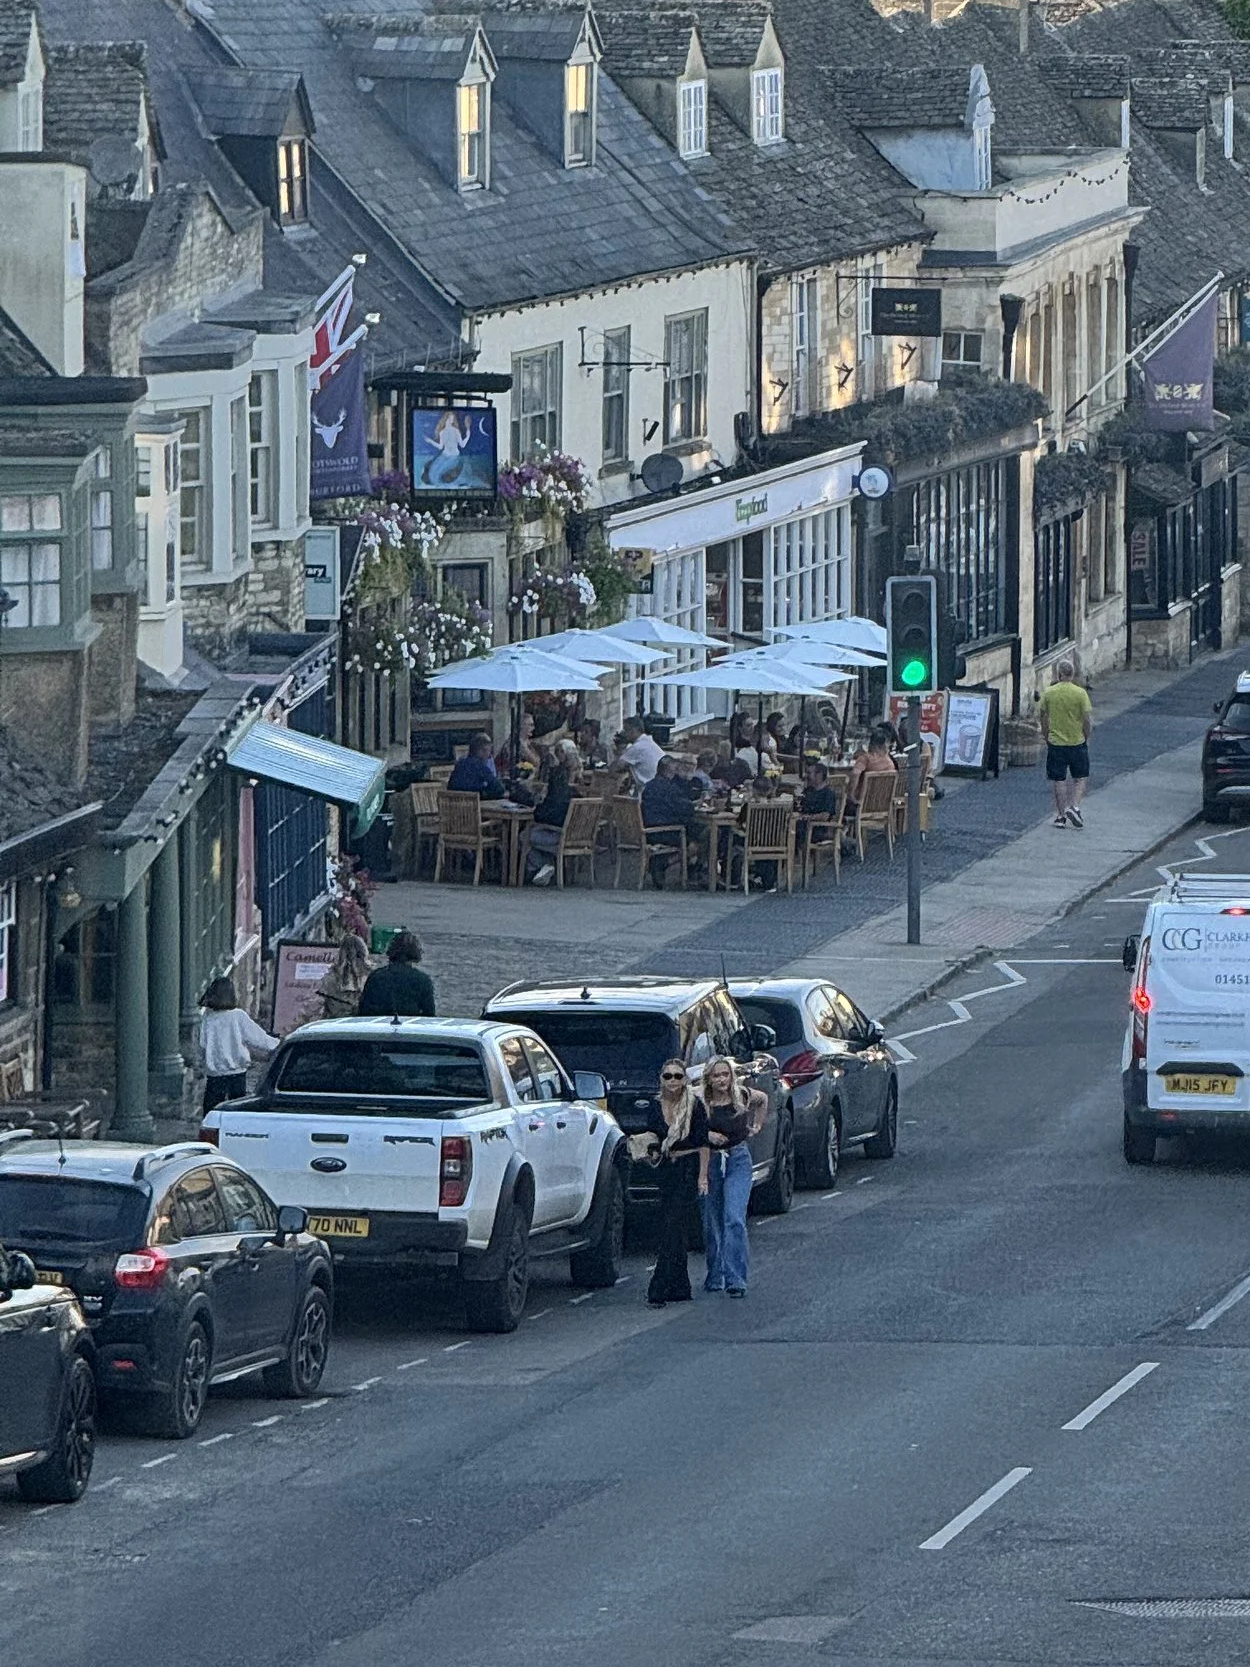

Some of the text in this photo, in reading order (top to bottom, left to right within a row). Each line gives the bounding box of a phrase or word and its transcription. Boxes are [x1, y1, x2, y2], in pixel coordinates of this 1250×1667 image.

[312, 456, 359, 468] OTSWOLD
[1215, 974, 1249, 984] 01451
[334, 1219, 362, 1234] NNL
